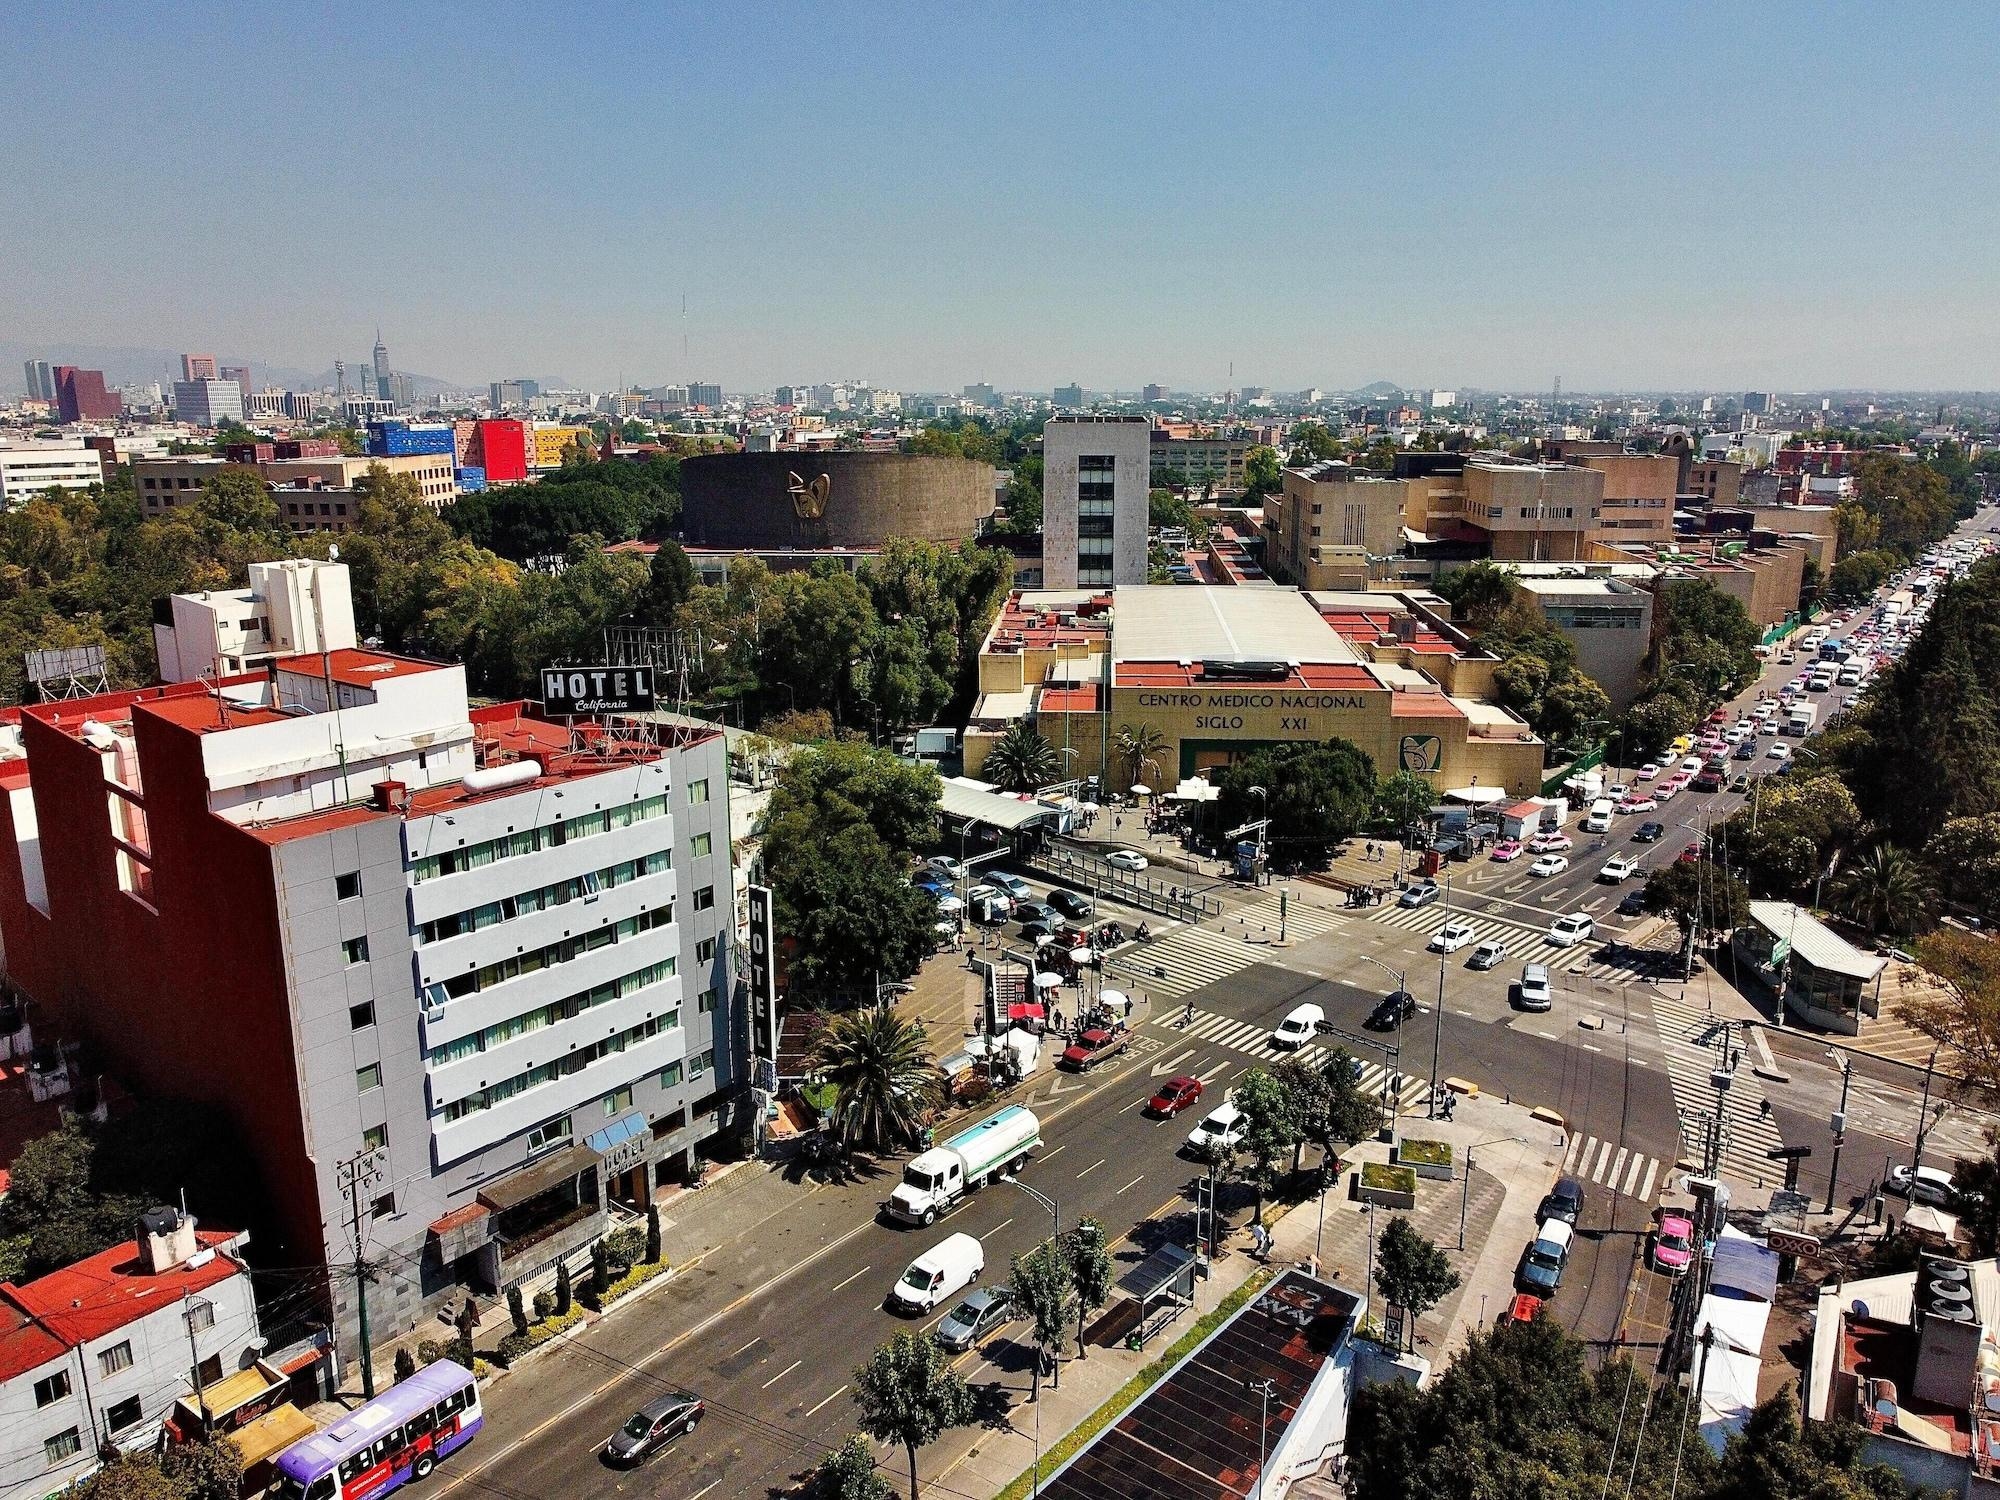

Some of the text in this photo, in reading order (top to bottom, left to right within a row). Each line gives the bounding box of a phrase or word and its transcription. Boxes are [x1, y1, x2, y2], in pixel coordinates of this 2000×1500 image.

[547, 671, 649, 699] HOTEL
[575, 699, 628, 713] California
[1139, 694, 1366, 709] CENTRO MEDICO NACIONAL
[1196, 716, 1308, 730] SIGLO XXI
[751, 900, 765, 1049] HOTEL
[1770, 1236, 1817, 1255] OXXO
